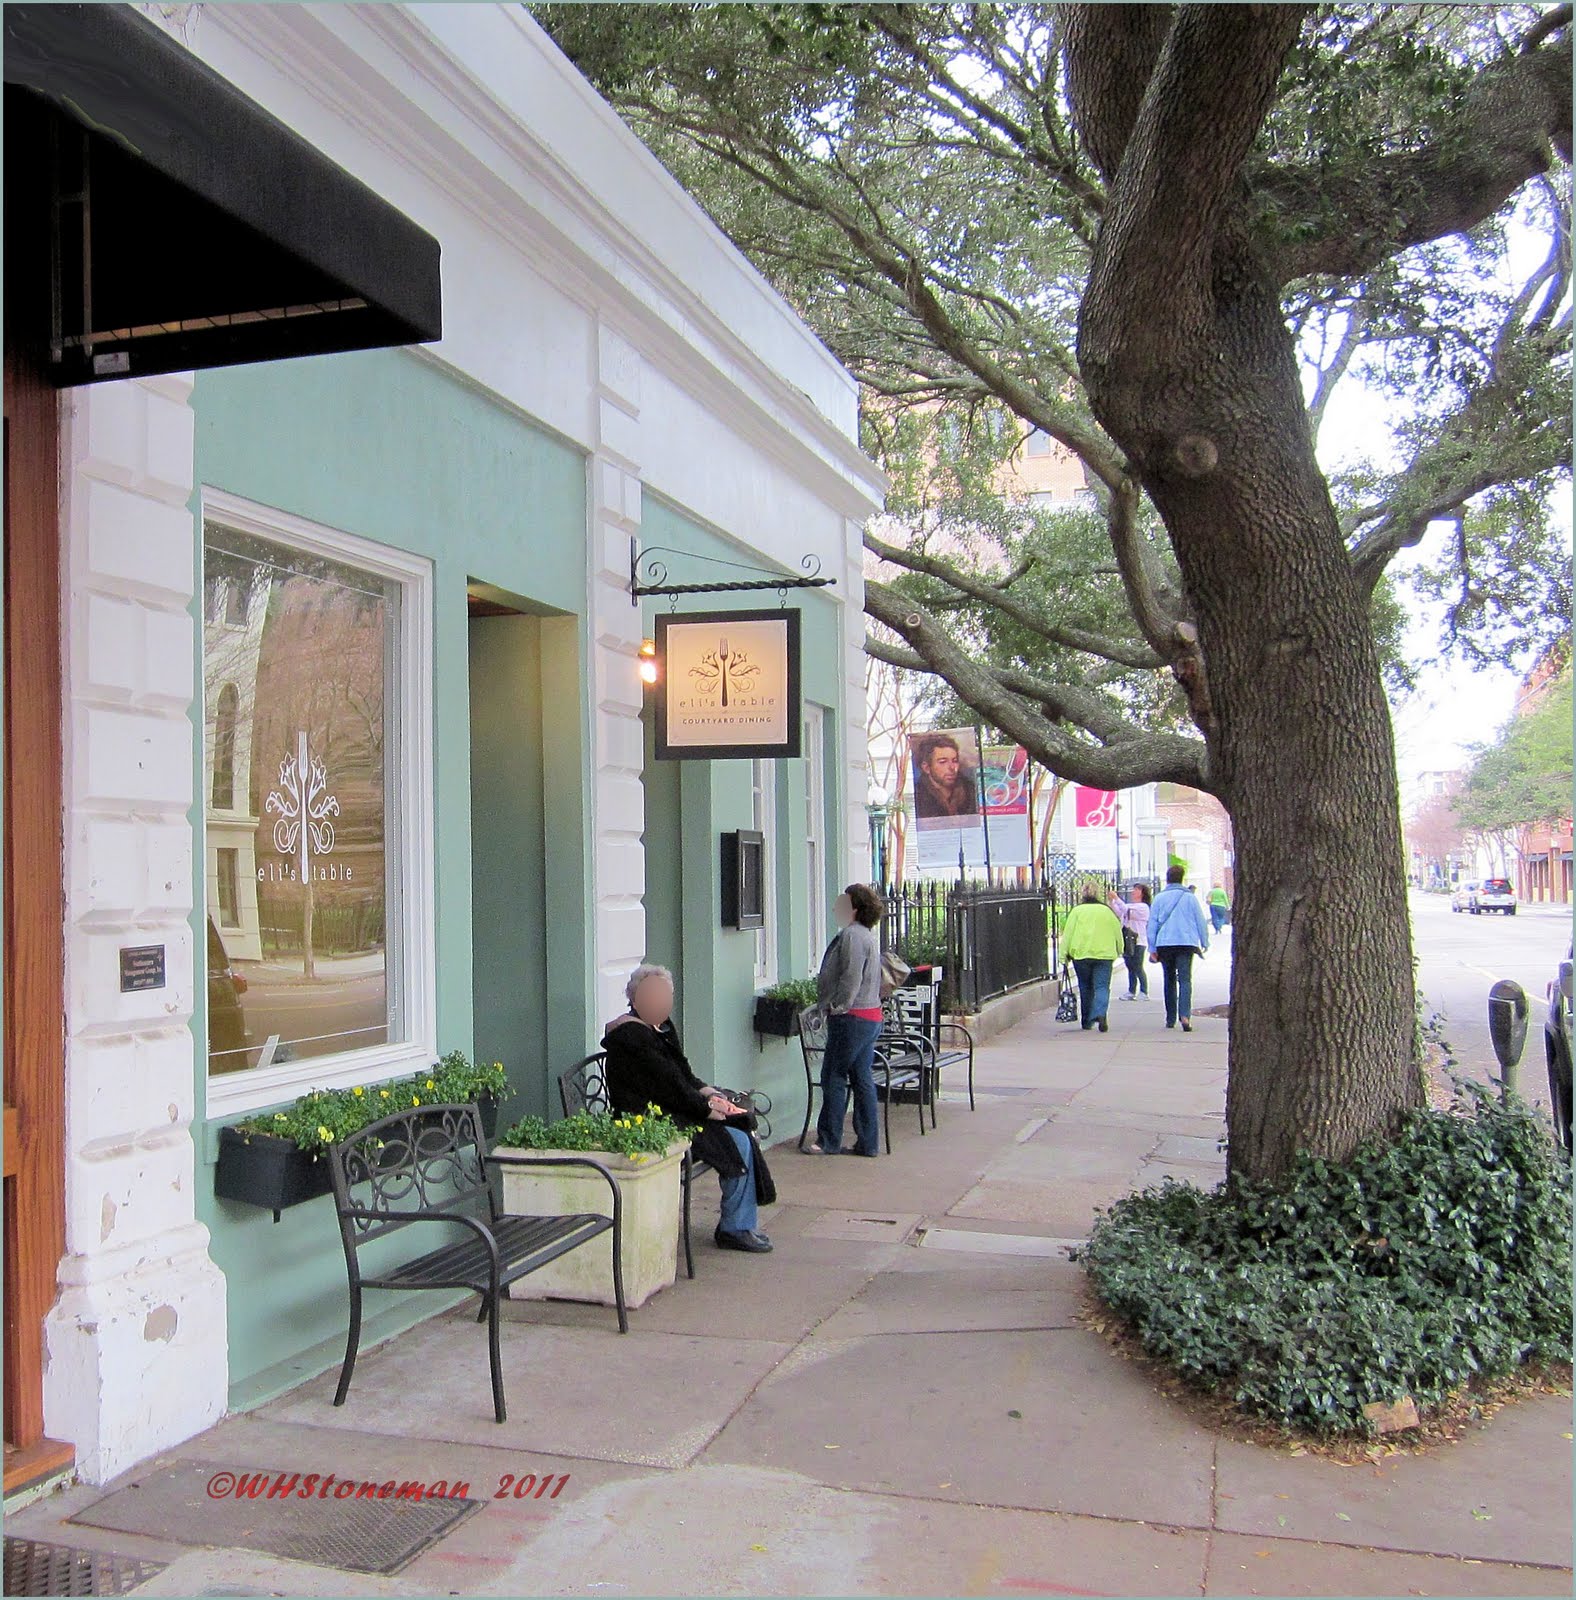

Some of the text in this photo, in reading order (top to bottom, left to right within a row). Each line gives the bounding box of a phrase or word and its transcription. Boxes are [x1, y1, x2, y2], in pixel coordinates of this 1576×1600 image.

[679, 696, 775, 708] eli's table
[682, 716, 772, 725] COURTYARD DINING
[257, 863, 353, 882] eli's table
